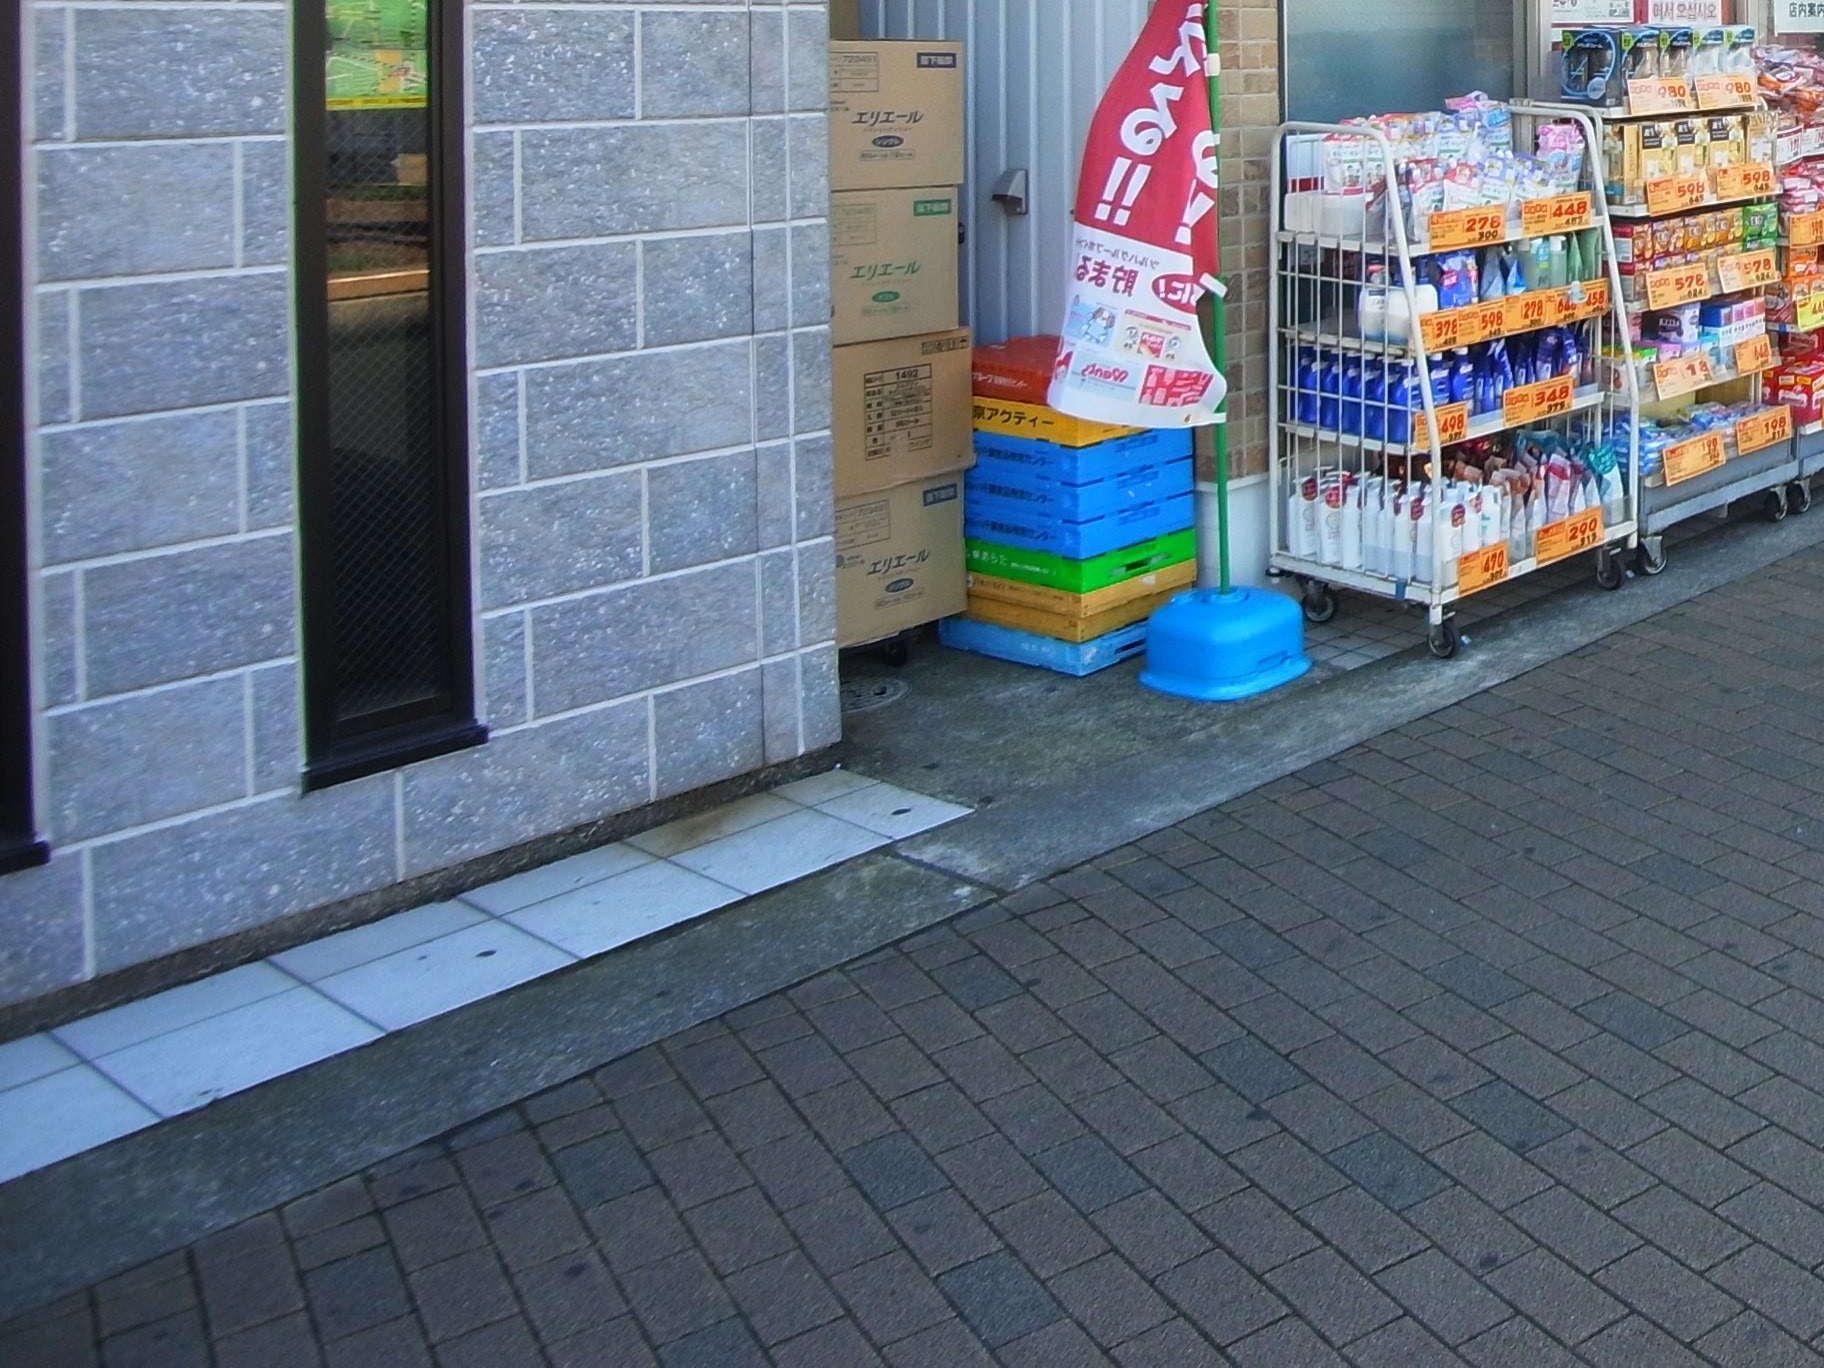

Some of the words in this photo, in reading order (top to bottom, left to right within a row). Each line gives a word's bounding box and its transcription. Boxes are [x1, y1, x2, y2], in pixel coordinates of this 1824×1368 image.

[1725, 81, 1751, 94] 980
[851, 110, 924, 127] エリエール
[1743, 170, 1771, 186] 598
[1677, 181, 1705, 198] 598
[1552, 201, 1588, 218] 448
[1465, 216, 1501, 233] 278
[1478, 230, 1499, 241] 300
[849, 260, 922, 281] エリエール
[1743, 257, 1772, 274] 578
[1674, 273, 1705, 292] 578
[1585, 289, 1605, 306] 458
[1522, 299, 1544, 320] 278
[1434, 317, 1458, 338] 378
[1480, 310, 1504, 331] 598
[1534, 385, 1570, 407] 348
[1441, 413, 1465, 435] 498
[1763, 415, 1787, 433] 198
[1568, 517, 1598, 542] 290
[867, 548, 931, 576] エリエール
[1483, 550, 1505, 573] 470
